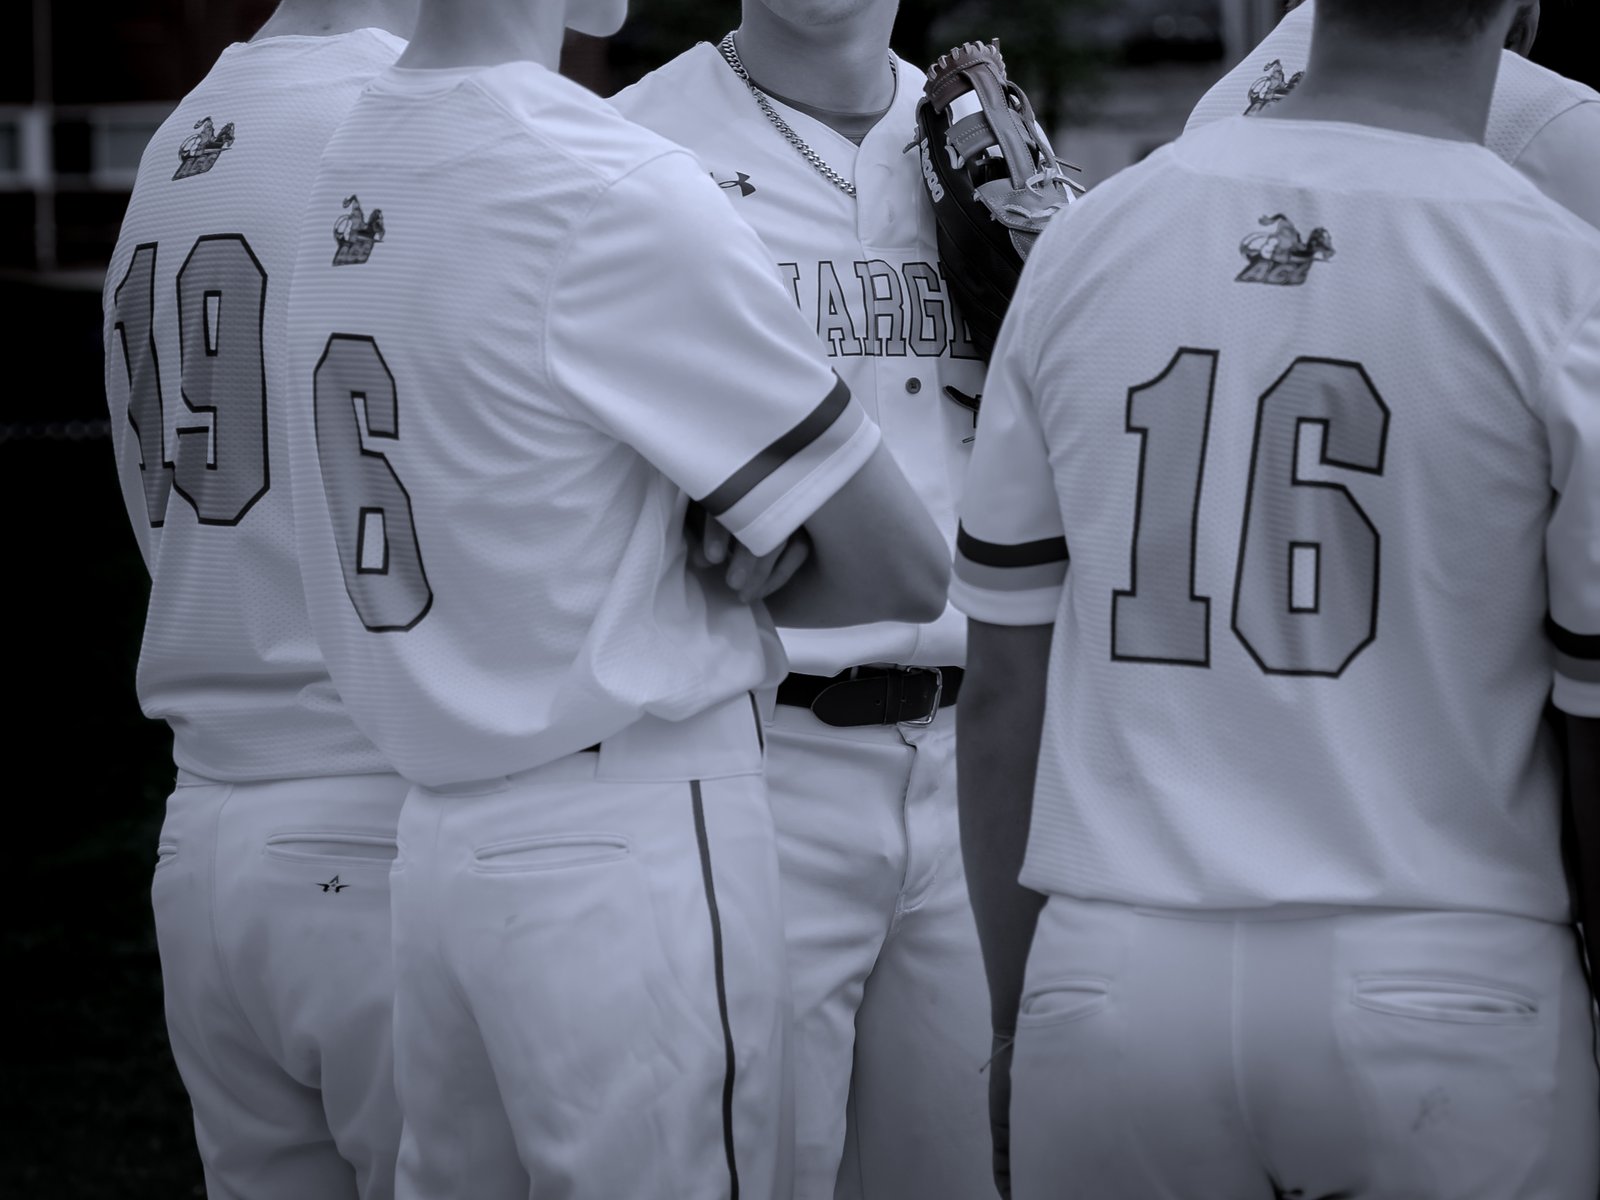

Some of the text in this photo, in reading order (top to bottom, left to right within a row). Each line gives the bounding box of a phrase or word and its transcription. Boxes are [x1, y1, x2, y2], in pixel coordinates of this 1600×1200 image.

[114, 233, 270, 528] 19
[313, 332, 434, 633] 6
[1110, 346, 1391, 678] 16
